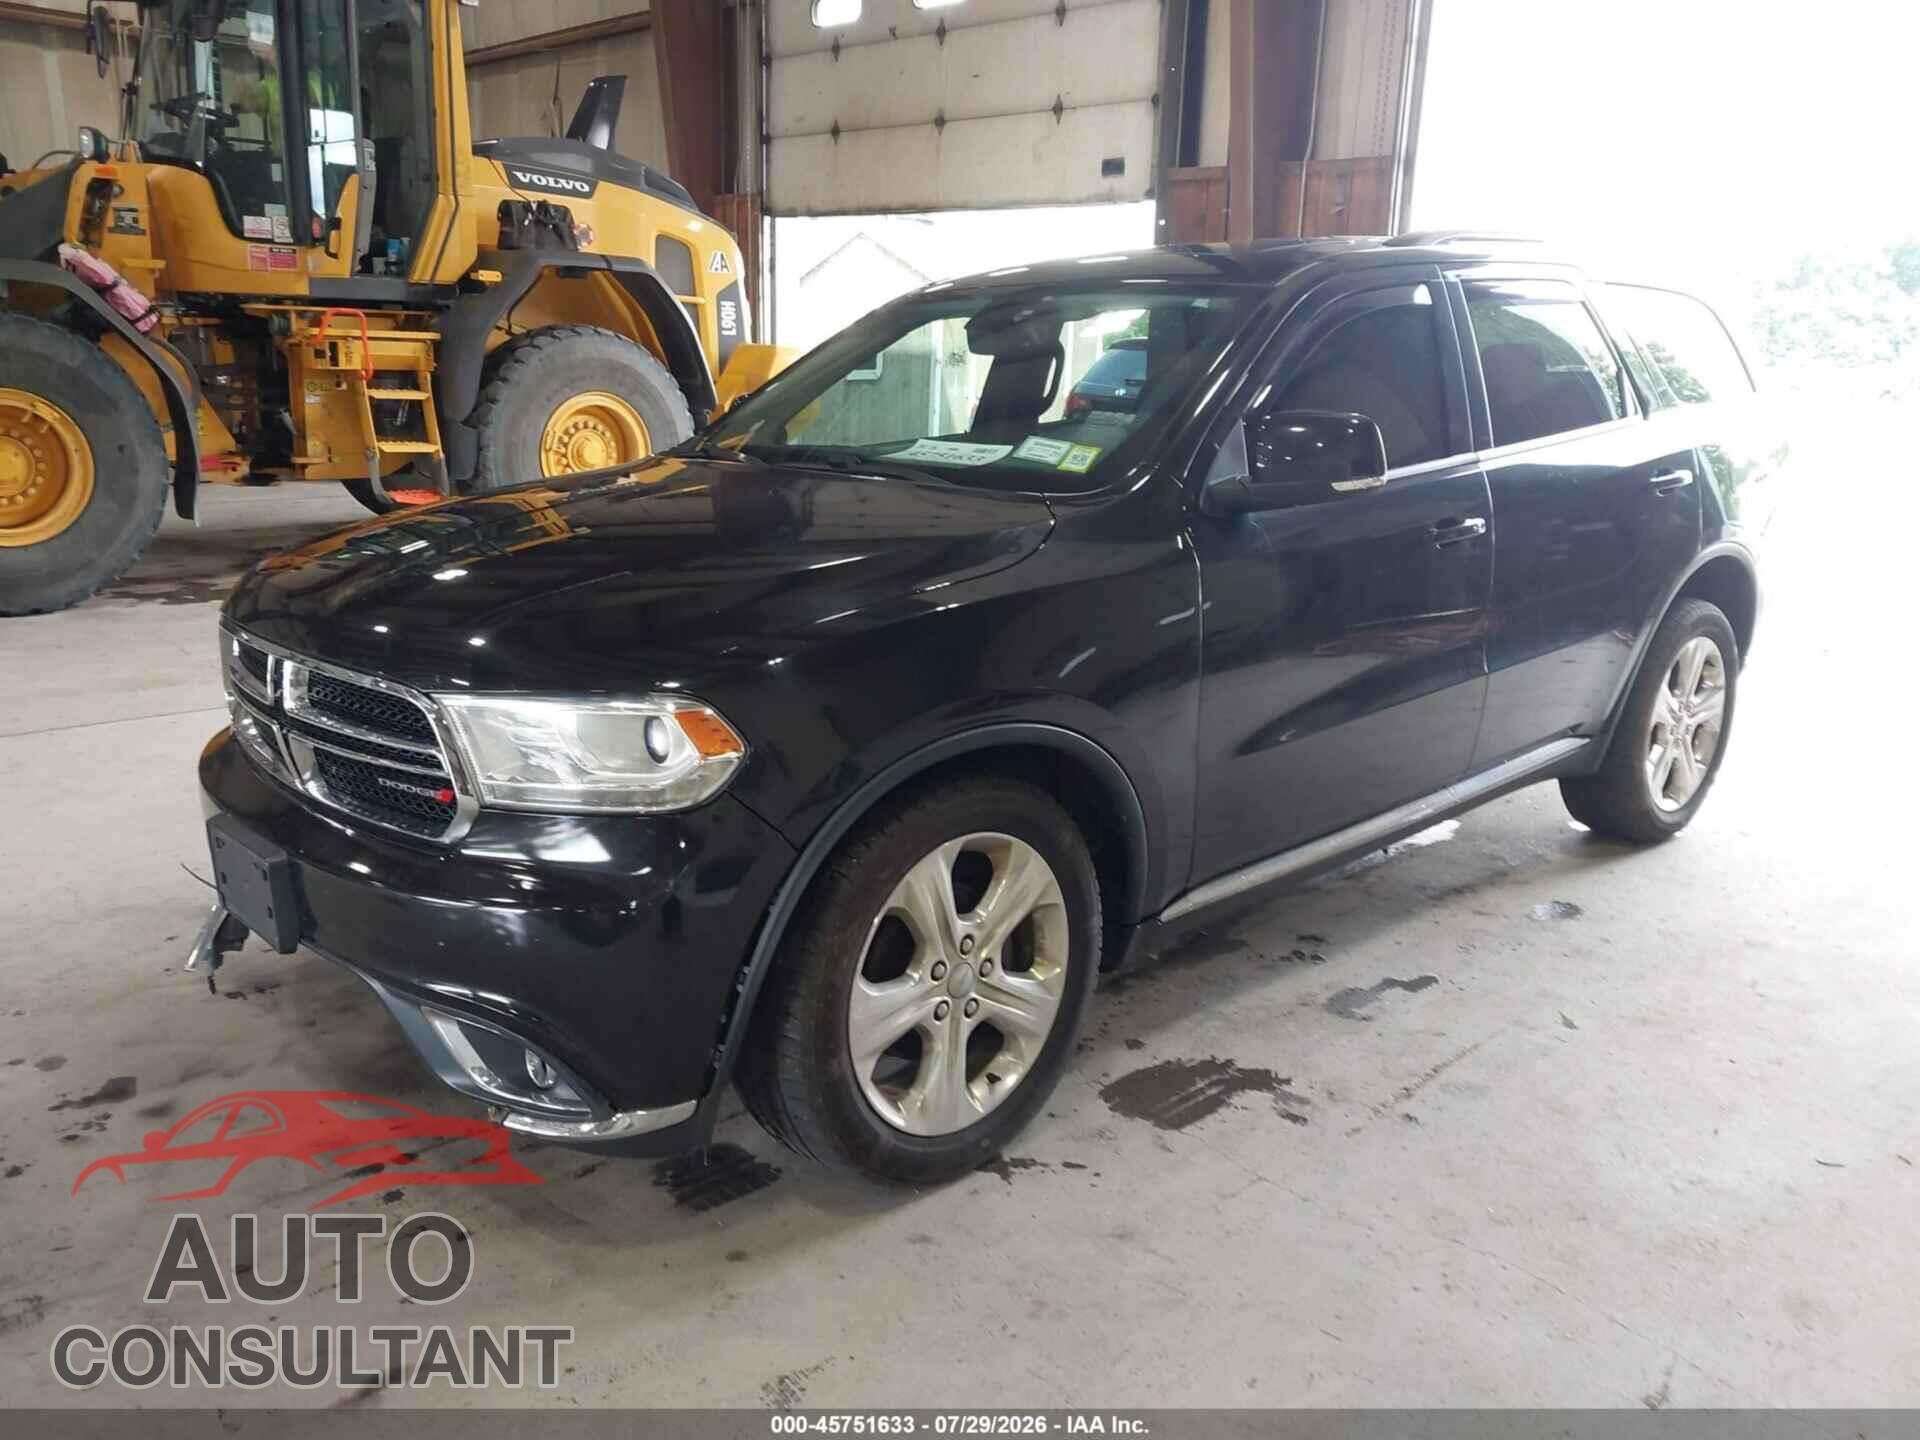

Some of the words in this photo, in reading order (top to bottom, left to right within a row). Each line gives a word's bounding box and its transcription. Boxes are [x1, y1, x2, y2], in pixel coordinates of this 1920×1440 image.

[511, 171, 591, 193] VOLVO
[719, 300, 737, 336] L90H
[377, 777, 441, 800] DODGE
